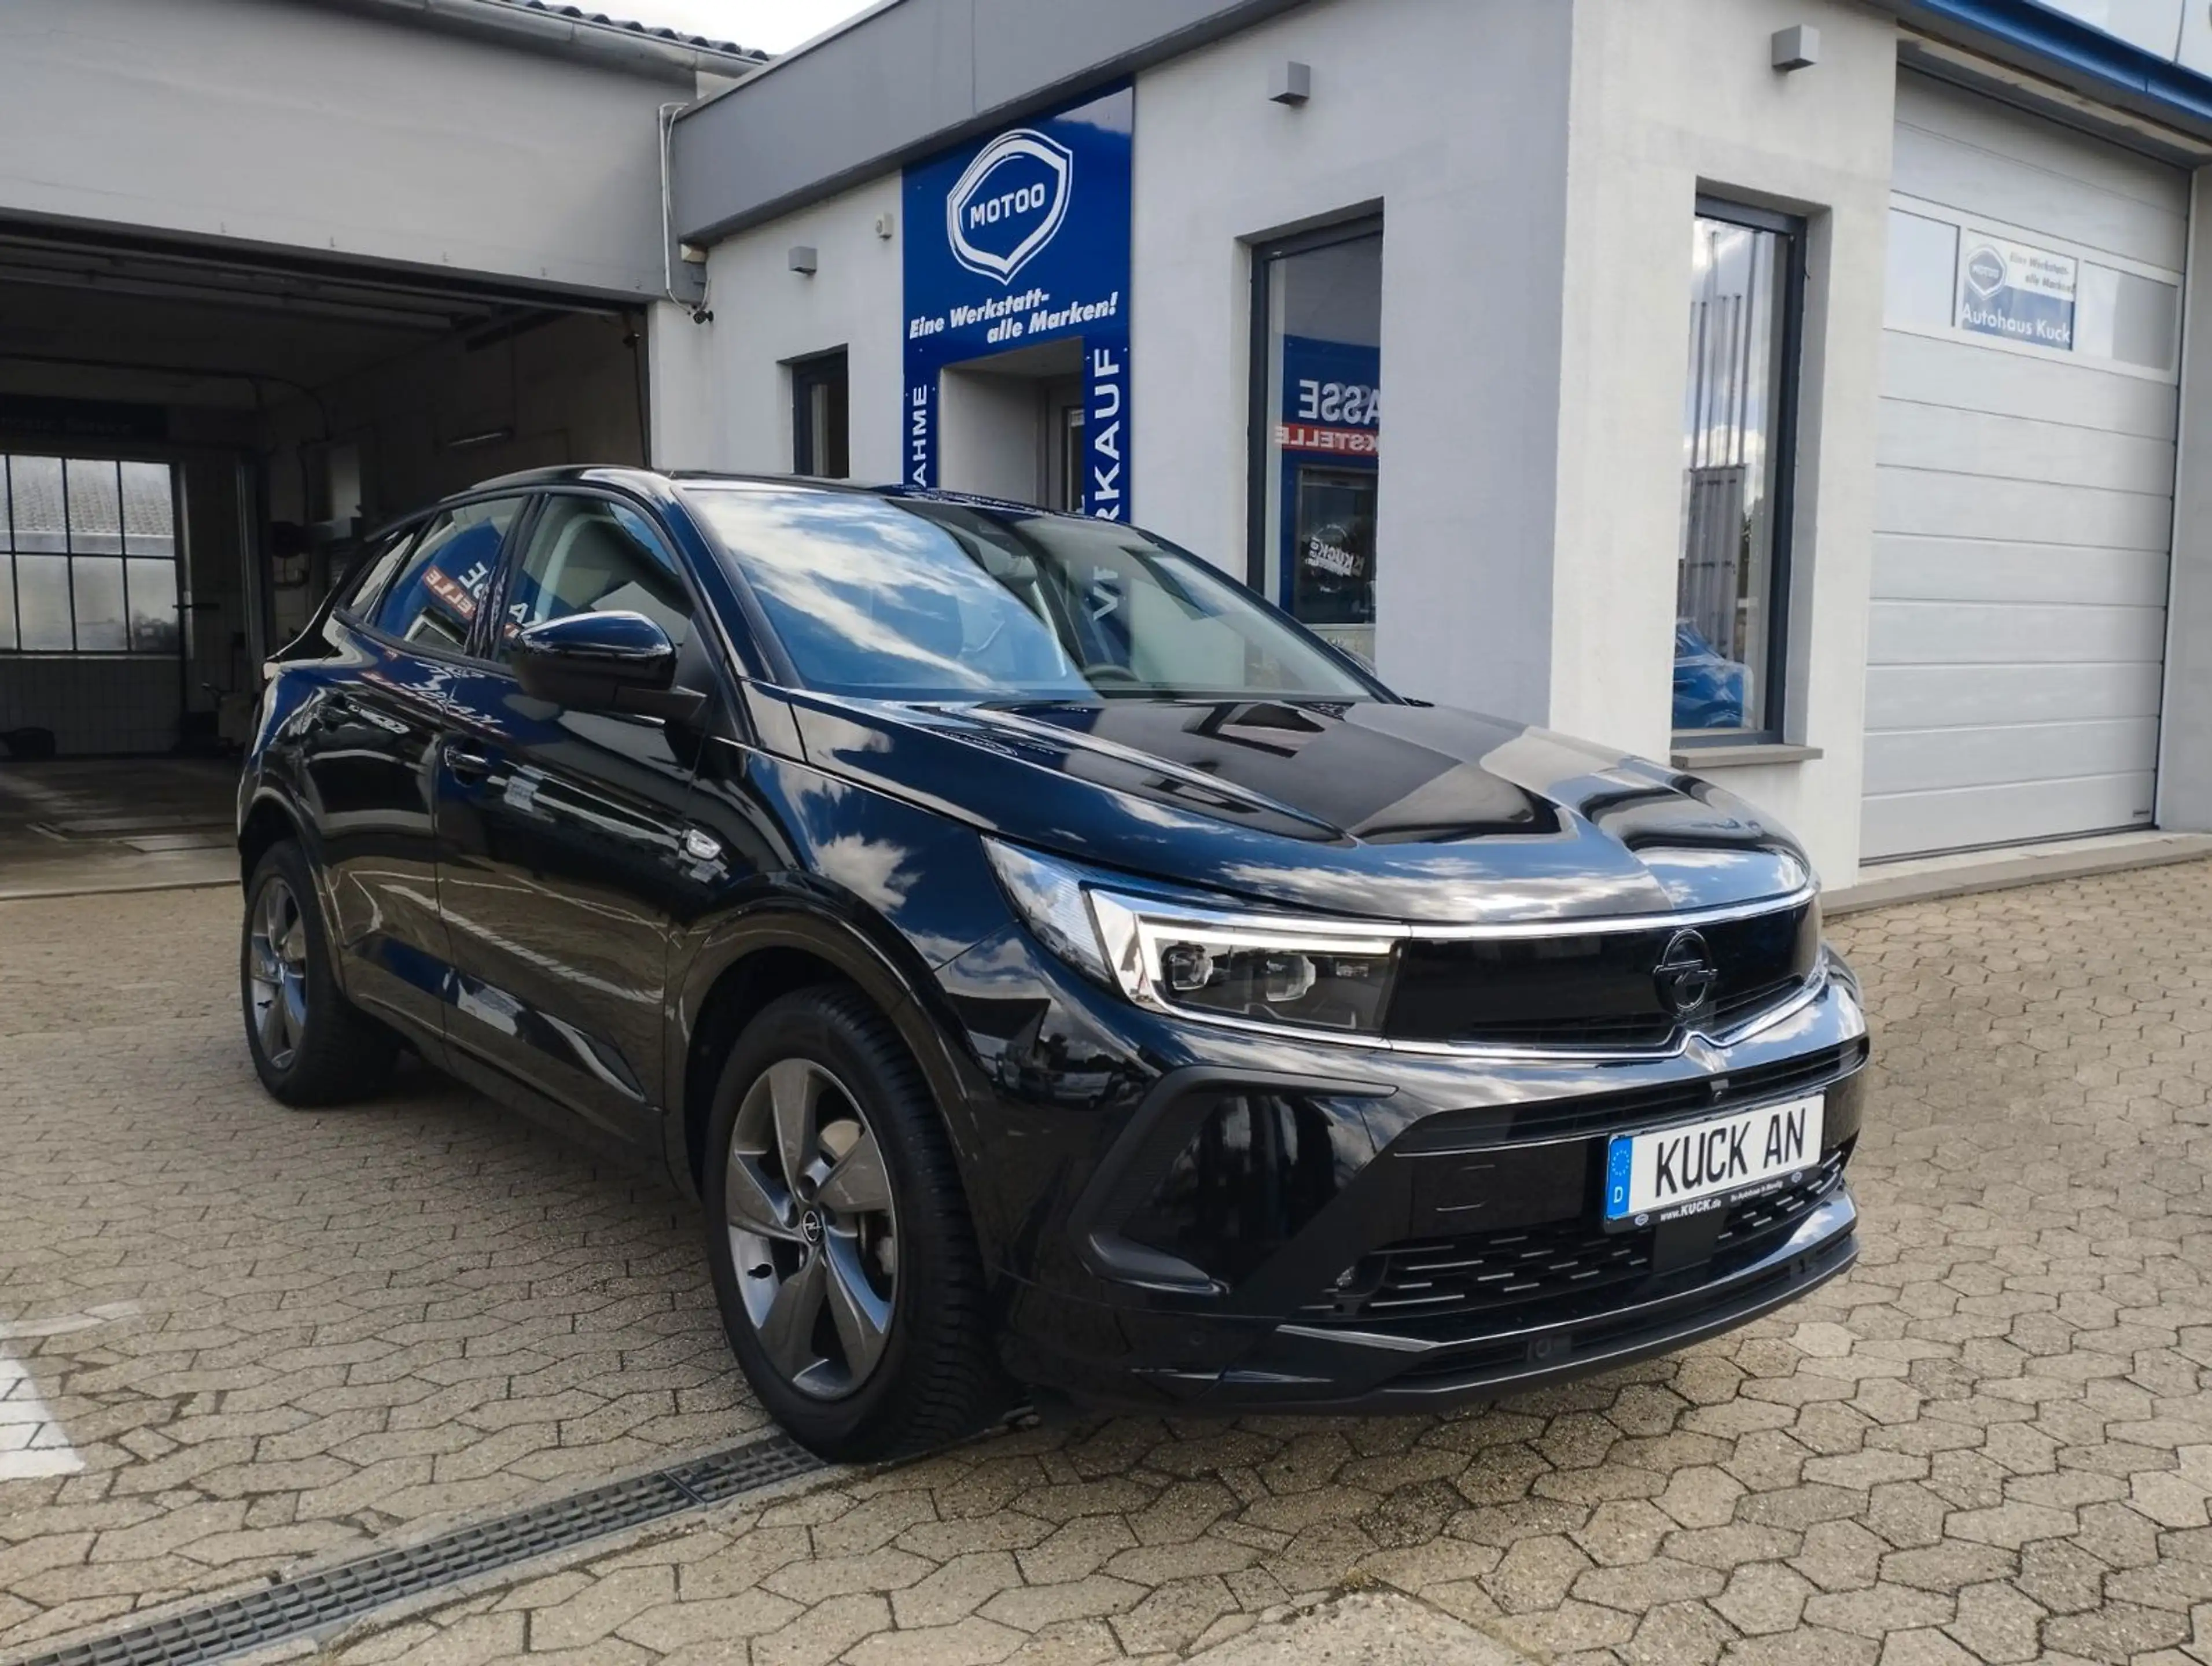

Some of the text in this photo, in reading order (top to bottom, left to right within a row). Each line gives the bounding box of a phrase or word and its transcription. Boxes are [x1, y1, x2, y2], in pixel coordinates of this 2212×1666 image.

[970, 182, 1046, 230] MOTOO
[909, 288, 1050, 340] Eine Werkstatt-
[986, 291, 1119, 344] alle Marken!
[1963, 303, 2070, 343] Autohaus Kuck
[1655, 1107, 1806, 1199] KUCK AN
[1613, 1186, 1624, 1204] D
[1660, 1198, 1721, 1222] www.KUCK.de
